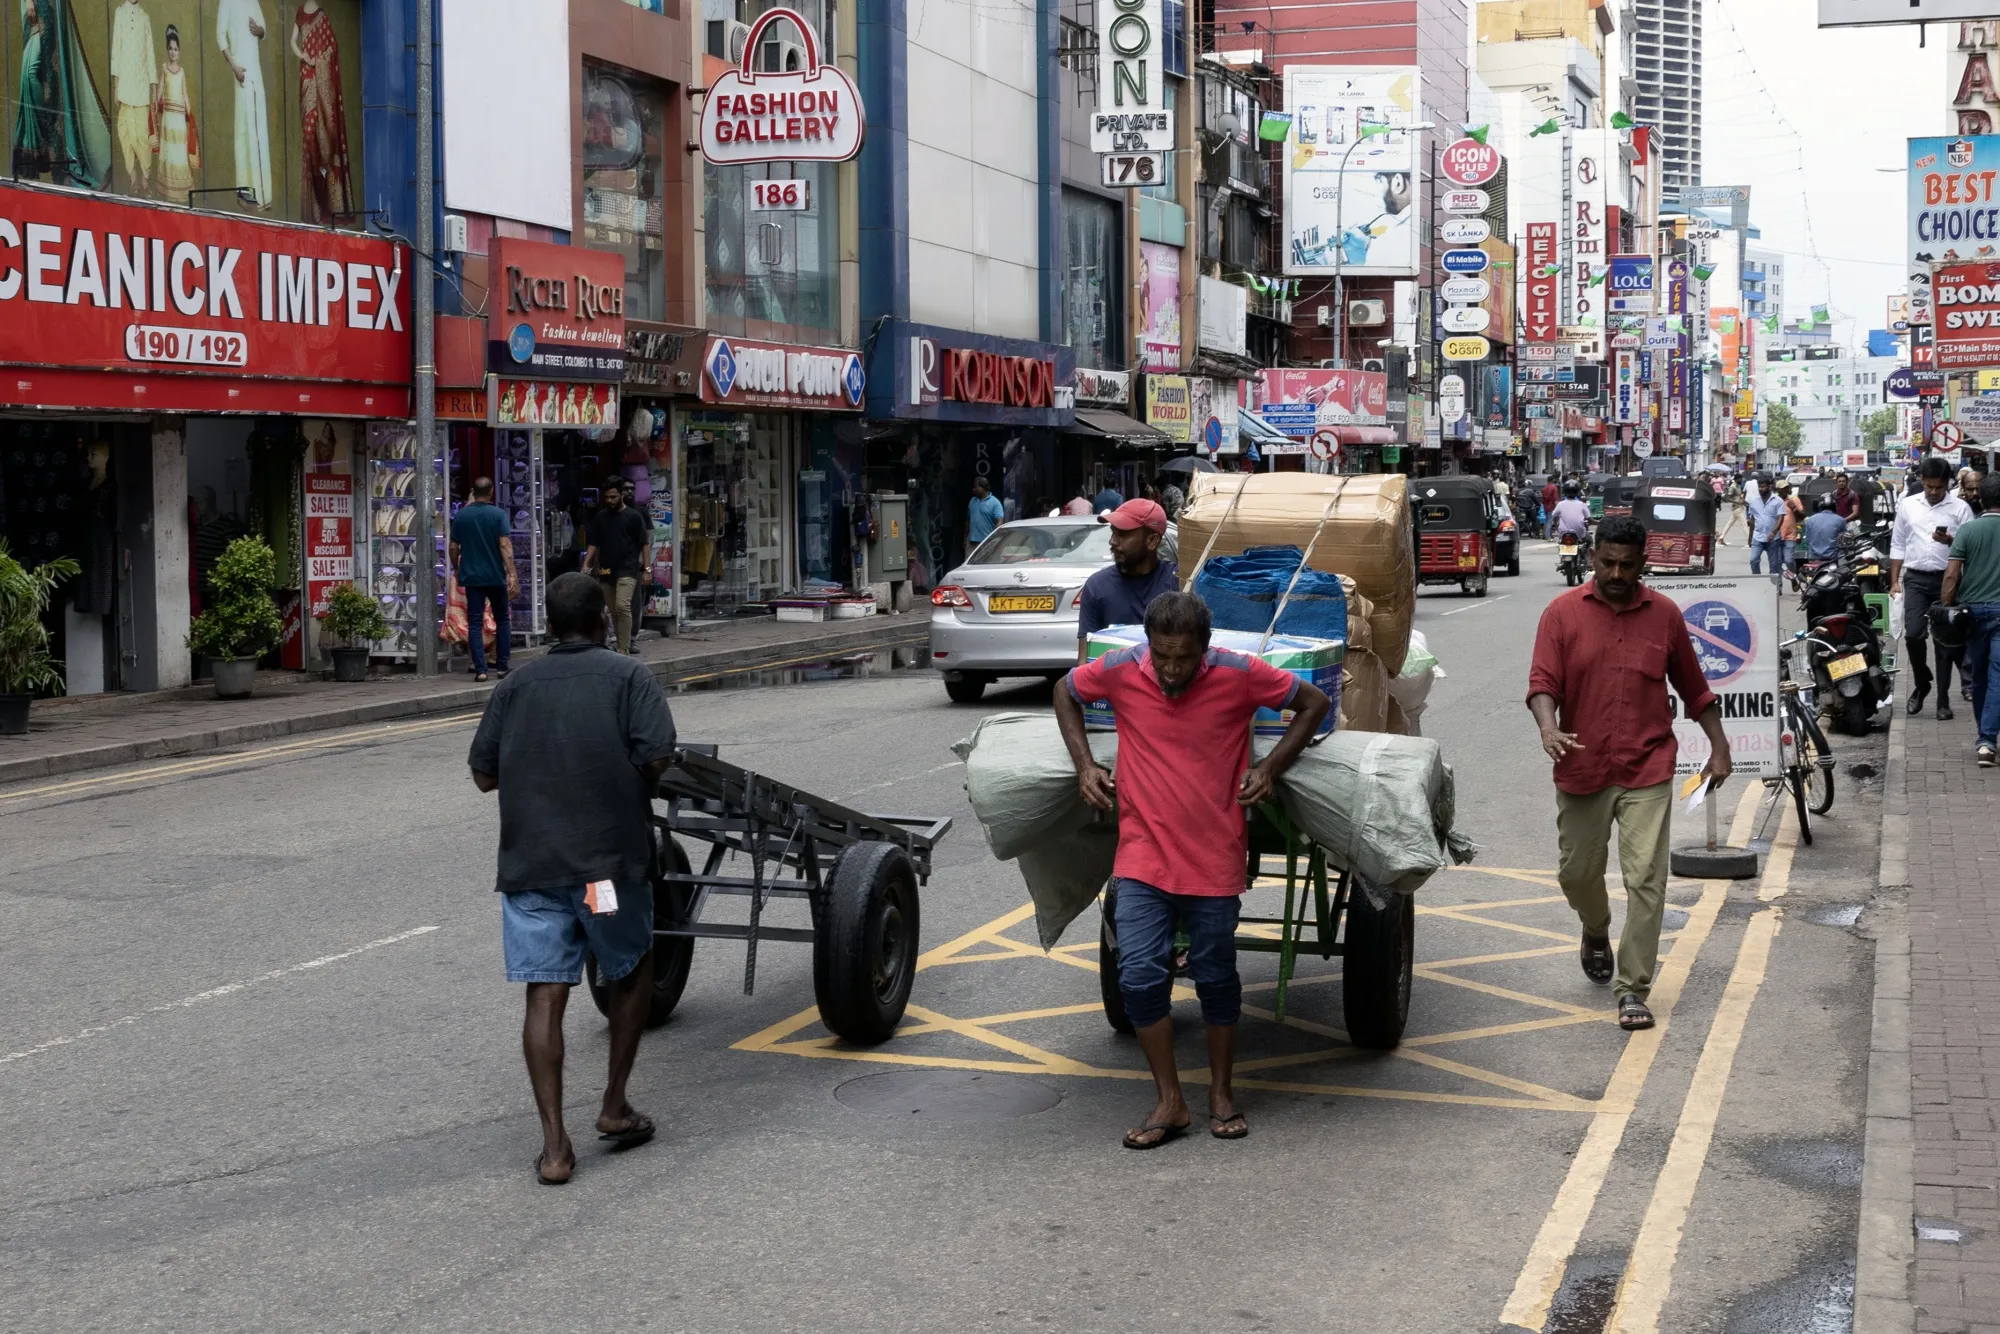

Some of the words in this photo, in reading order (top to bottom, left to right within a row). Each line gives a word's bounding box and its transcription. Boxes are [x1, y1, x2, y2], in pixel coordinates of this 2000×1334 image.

[717, 90, 838, 117] FASHION
[715, 116, 839, 143] GALLERY
[1096, 113, 1167, 132] PRIVATE
[1112, 132, 1148, 149] LTD.
[1451, 148, 1490, 163] ICON
[1916, 153, 1936, 169] NEW
[1950, 154, 1969, 164] NBC
[1109, 156, 1154, 182] 176
[1455, 163, 1488, 172] HUB
[754, 184, 797, 207] 186
[1923, 171, 1998, 205] BEST
[1453, 194, 1478, 202] RED
[1917, 208, 2000, 242] CHOICE
[1456, 255, 1483, 263] Mobile
[1615, 275, 1651, 288] LOLC
[1940, 274, 1965, 283] First
[260, 251, 404, 332] IMPEX
[574, 274, 625, 320] RICH
[543, 322, 577, 340] Fashion
[581, 326, 622, 349] Jewellery
[1648, 337, 1676, 345] OutFit
[134, 327, 179, 360] 190
[201, 334, 242, 363] 192
[1959, 344, 1980, 353] Main
[734, 347, 785, 392] RICH
[786, 352, 843, 397] POINT
[944, 349, 1055, 407] ROBINSON
[1286, 371, 1308, 380] Coca-Cola
[1157, 387, 1185, 403] FASHION
[451, 397, 484, 412] Rich
[1152, 406, 1187, 420] WORLD
[312, 479, 346, 491] CLEARANCE
[311, 497, 334, 514] SALE
[321, 529, 339, 544] 50%
[314, 545, 346, 556] DISCOUNT
[313, 560, 335, 576] SALE
[1026, 598, 1052, 609] 0925
